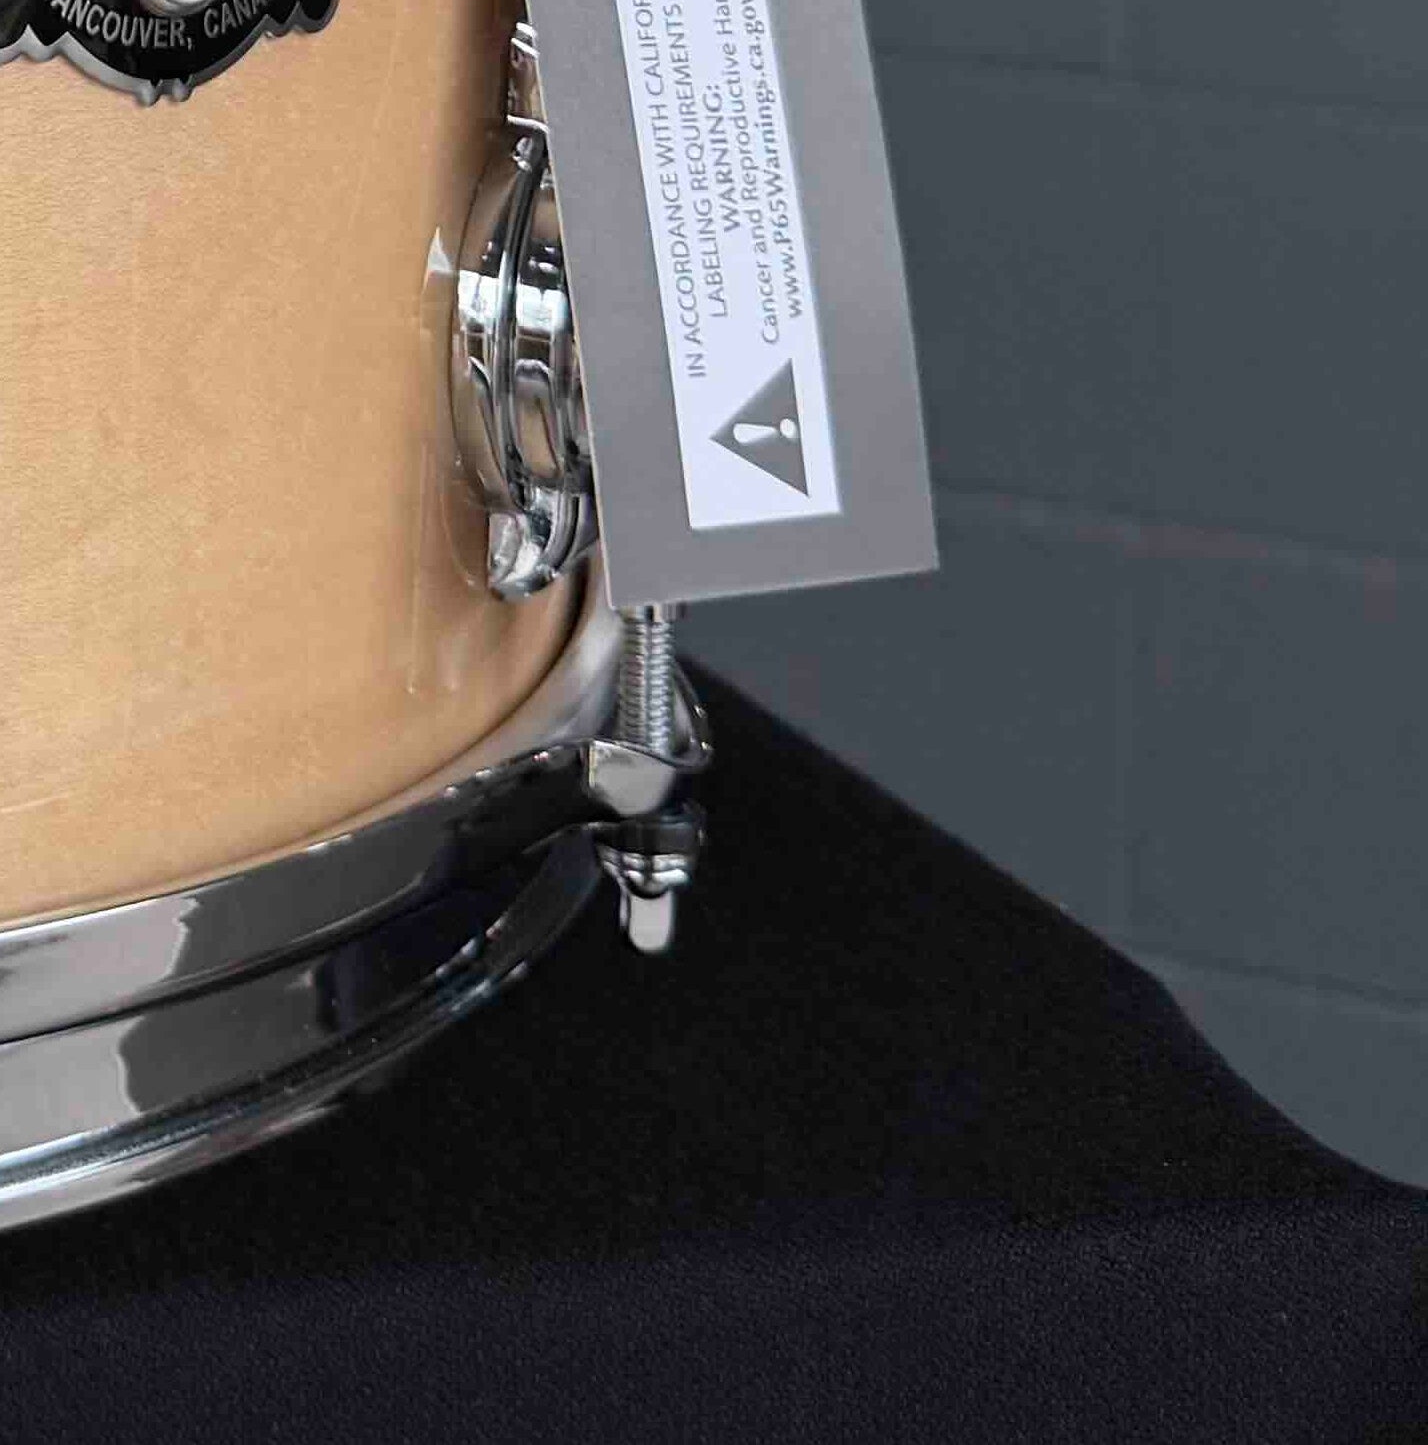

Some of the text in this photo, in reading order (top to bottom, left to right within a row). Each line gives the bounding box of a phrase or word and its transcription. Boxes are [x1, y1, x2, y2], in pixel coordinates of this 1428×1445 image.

[647, 104, 676, 167] WITH
[663, 3, 728, 318] LABELING REQUIREMENTS
[703, 84, 741, 232] WARNING:
[712, 43, 760, 201] Reproductive
[660, 173, 704, 346] ACCORDANCE
[744, 209, 767, 255] and
[755, 260, 780, 345] Cancer
[686, 352, 706, 378] IN
